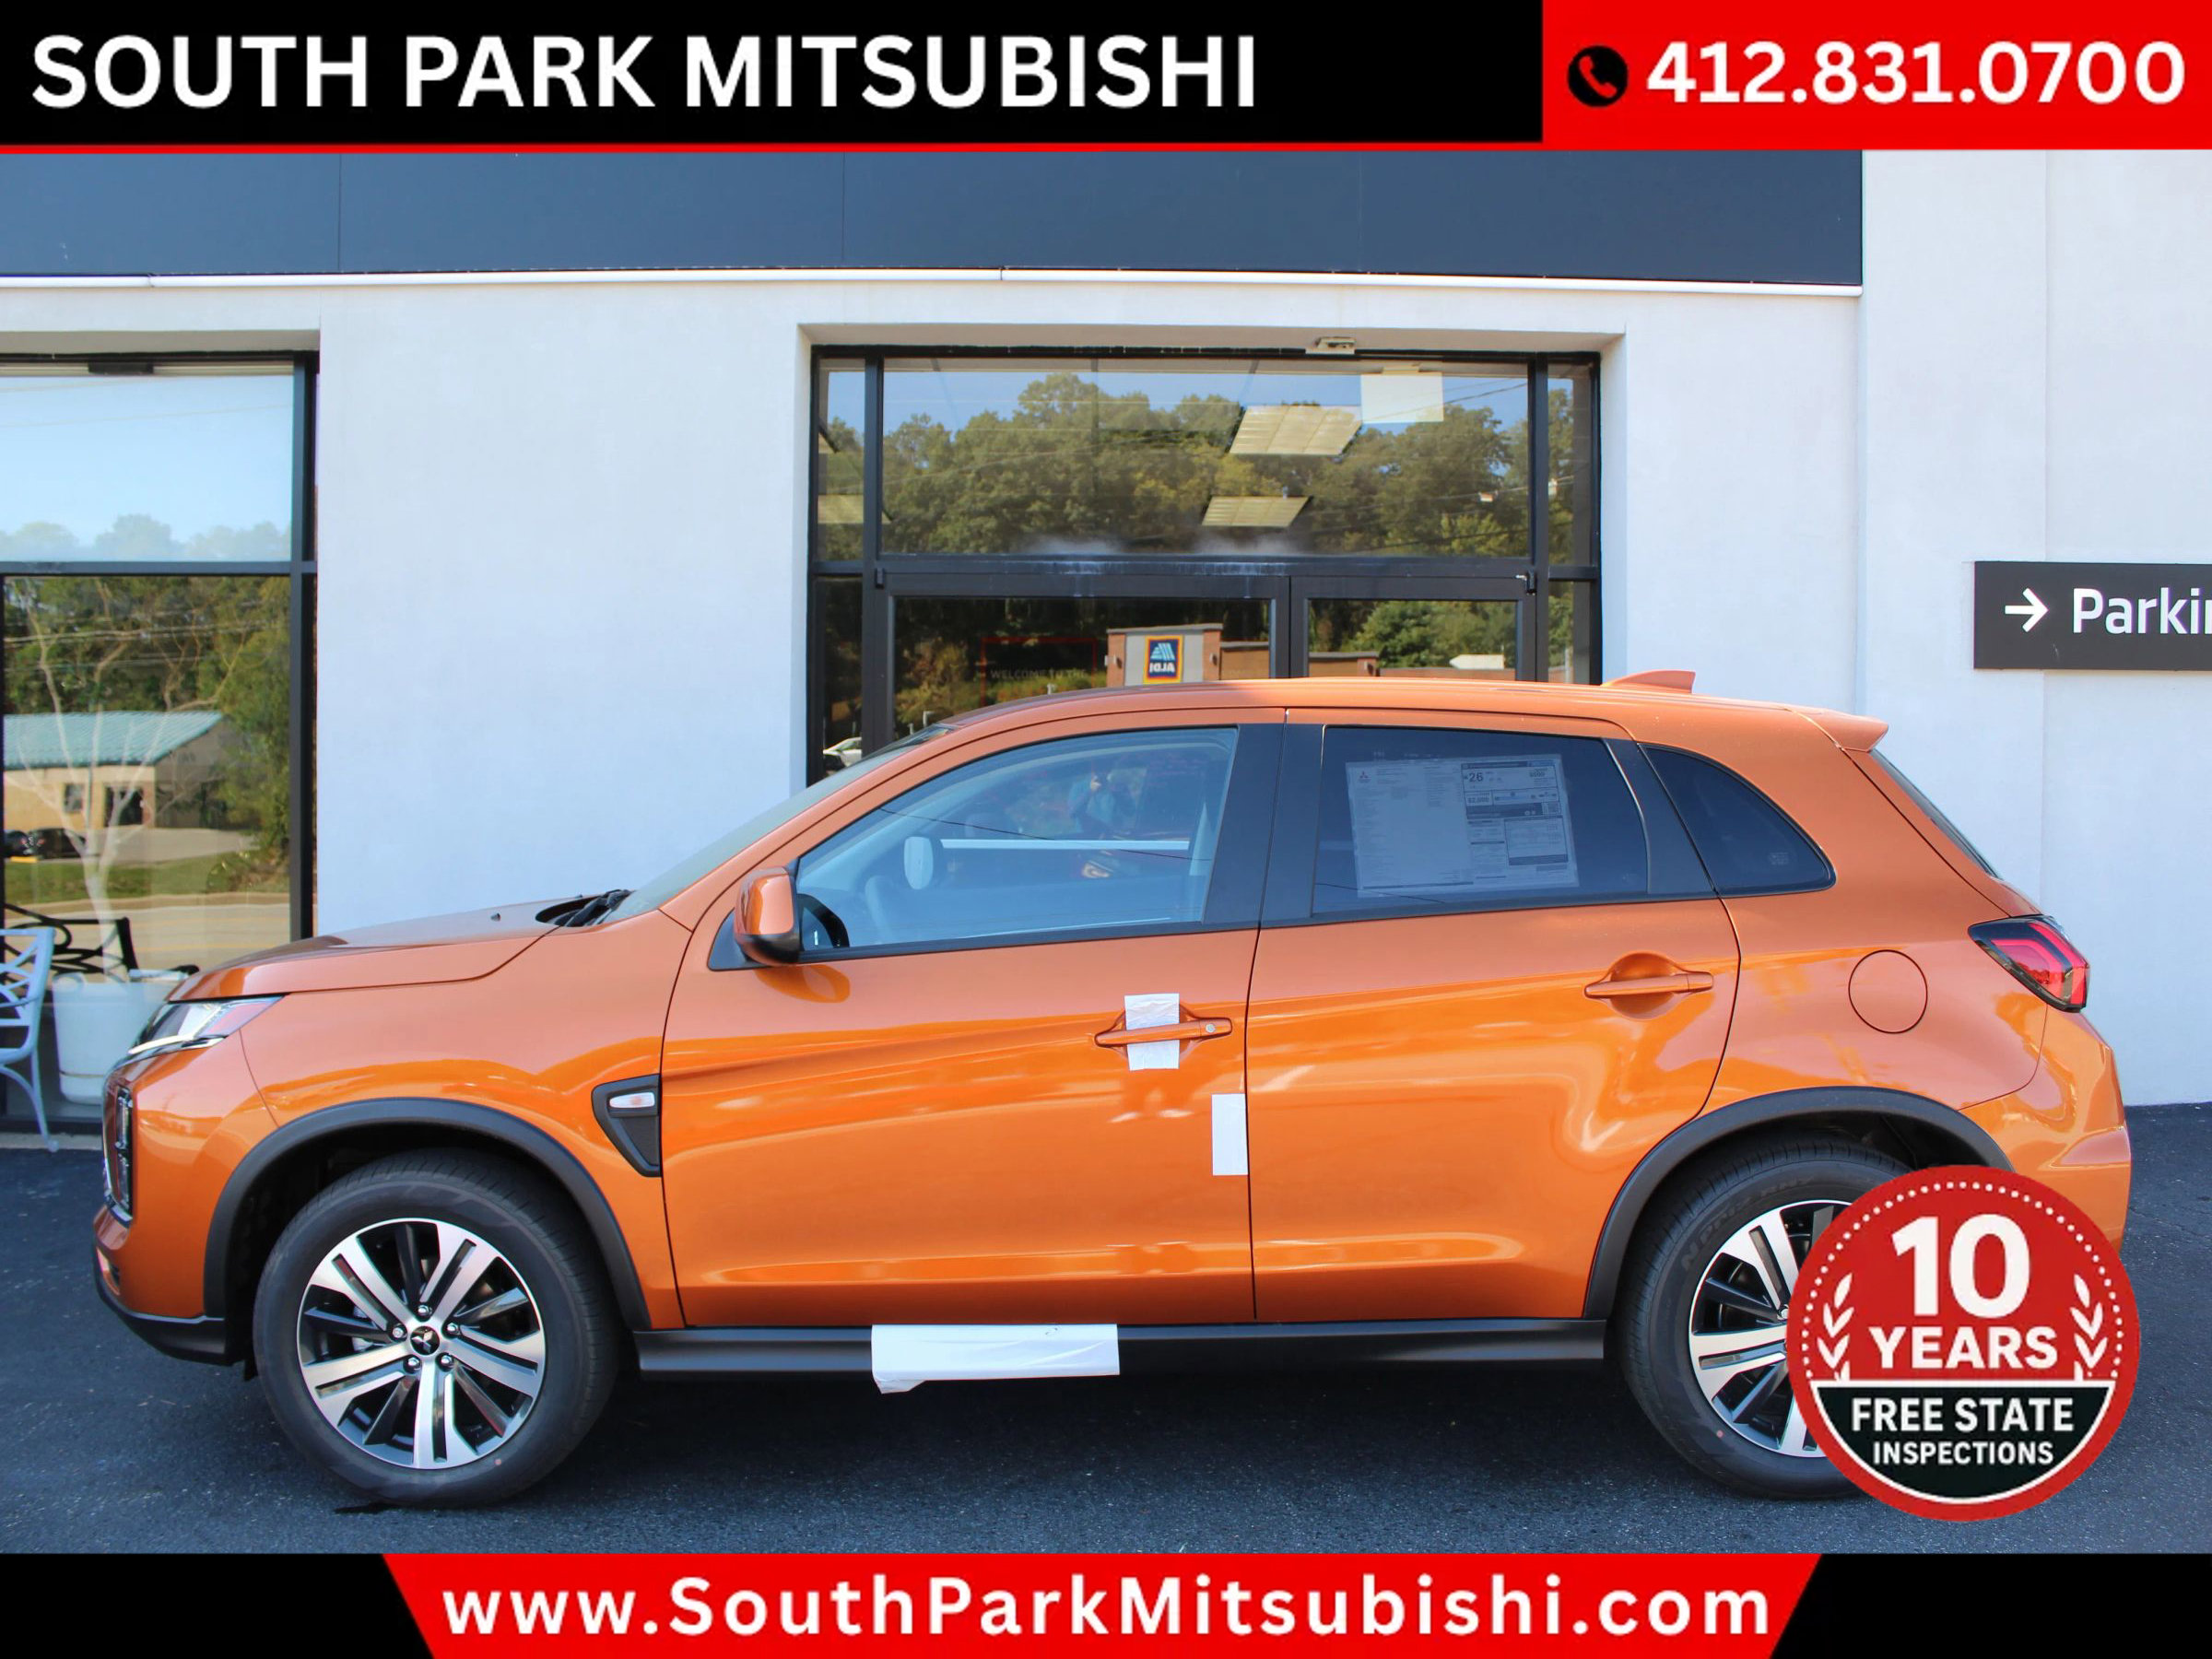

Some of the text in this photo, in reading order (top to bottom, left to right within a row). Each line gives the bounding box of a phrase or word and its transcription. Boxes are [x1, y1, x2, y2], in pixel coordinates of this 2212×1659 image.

[2073, 587, 2212, 635] Parki
[990, 669, 1045, 680] WELCOME
[1468, 771, 1483, 782] 26
